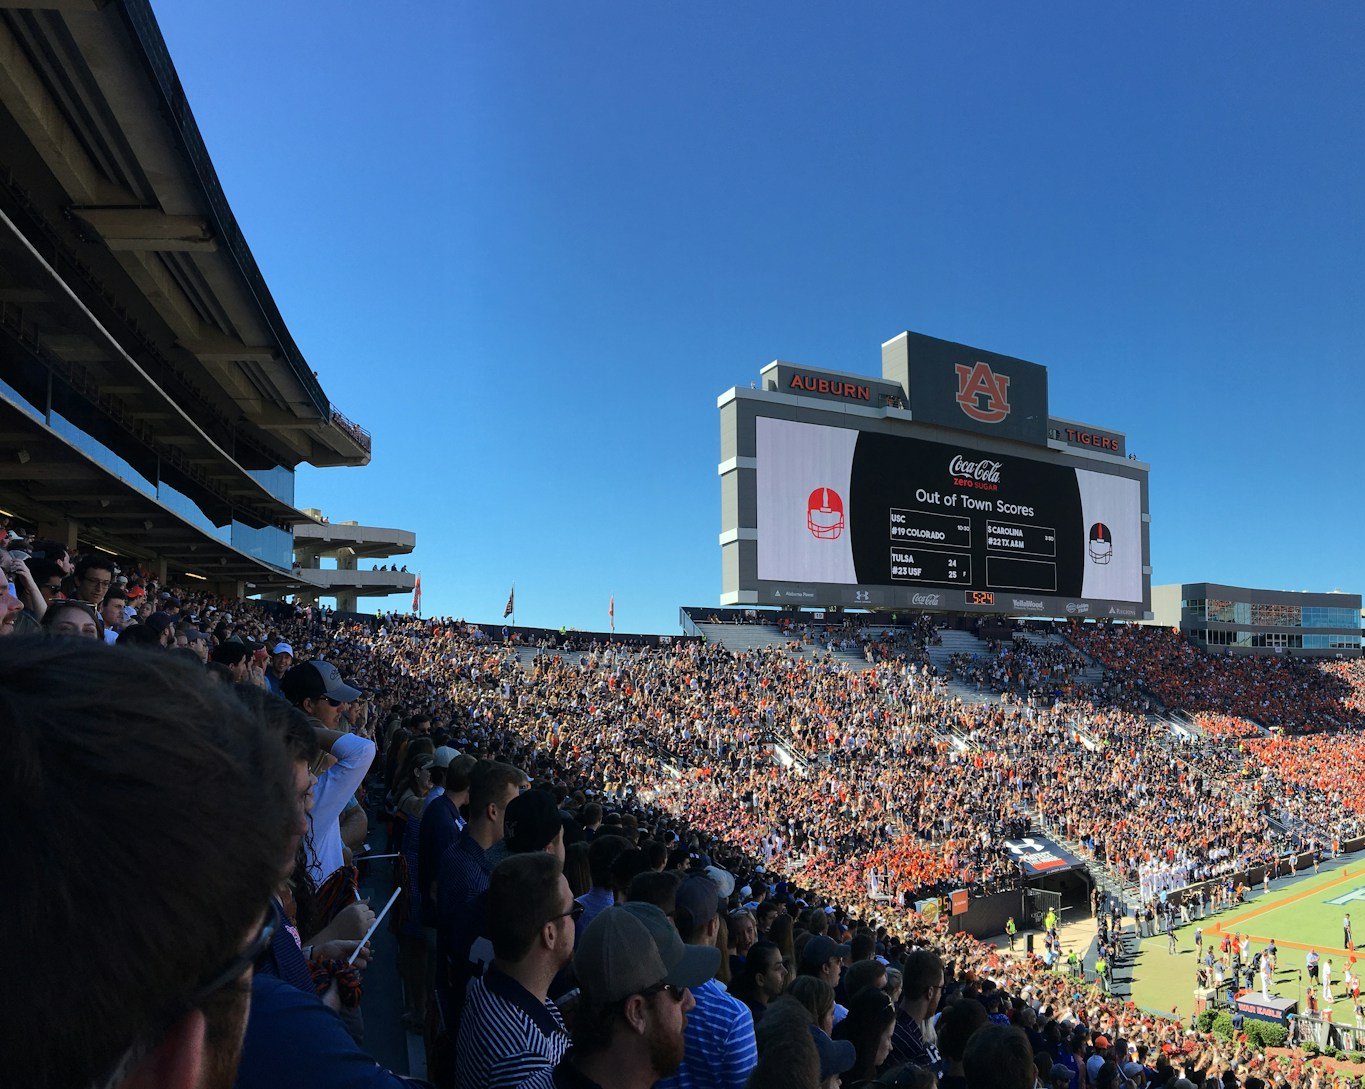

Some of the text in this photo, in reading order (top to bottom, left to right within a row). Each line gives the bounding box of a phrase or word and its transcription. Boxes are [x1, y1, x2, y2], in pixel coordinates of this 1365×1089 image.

[790, 374, 871, 400] AUBURN
[1066, 428, 1119, 452] TIGERS
[949, 455, 1003, 483] Coca-Cola
[953, 477, 998, 491] zero SUGAR
[915, 488, 1035, 517] Out of Town Scores
[891, 513, 906, 524] USC
[891, 526, 946, 540] #19 COLORADO
[992, 526, 1024, 538] CAROLINA
[988, 536, 1025, 549] #22 TX A&M
[891, 553, 915, 564] TULSA
[948, 559, 957, 568] 24
[892, 566, 922, 576] #23 USF
[948, 570, 957, 579] 25
[972, 591, 994, 605] 5:24
[1238, 1003, 1283, 1019] WAR EAGLE
